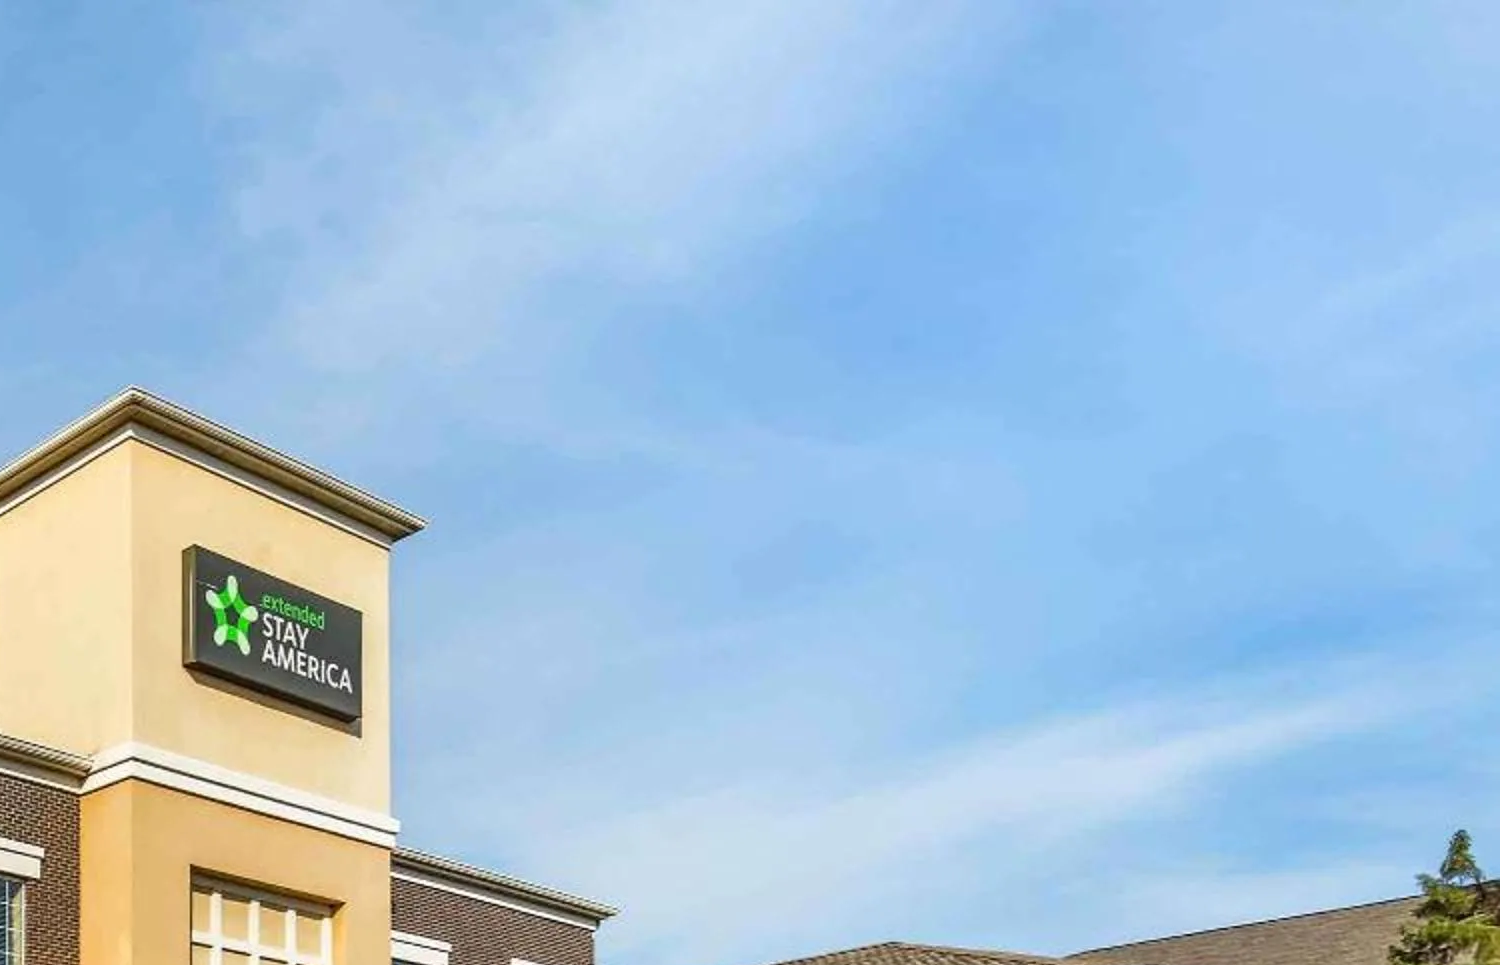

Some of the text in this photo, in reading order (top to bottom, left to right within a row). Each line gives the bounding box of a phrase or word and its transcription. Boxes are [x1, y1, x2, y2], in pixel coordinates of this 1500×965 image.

[262, 612, 309, 650] STAY
[263, 594, 325, 630] extended
[261, 639, 353, 694] AMERICA
